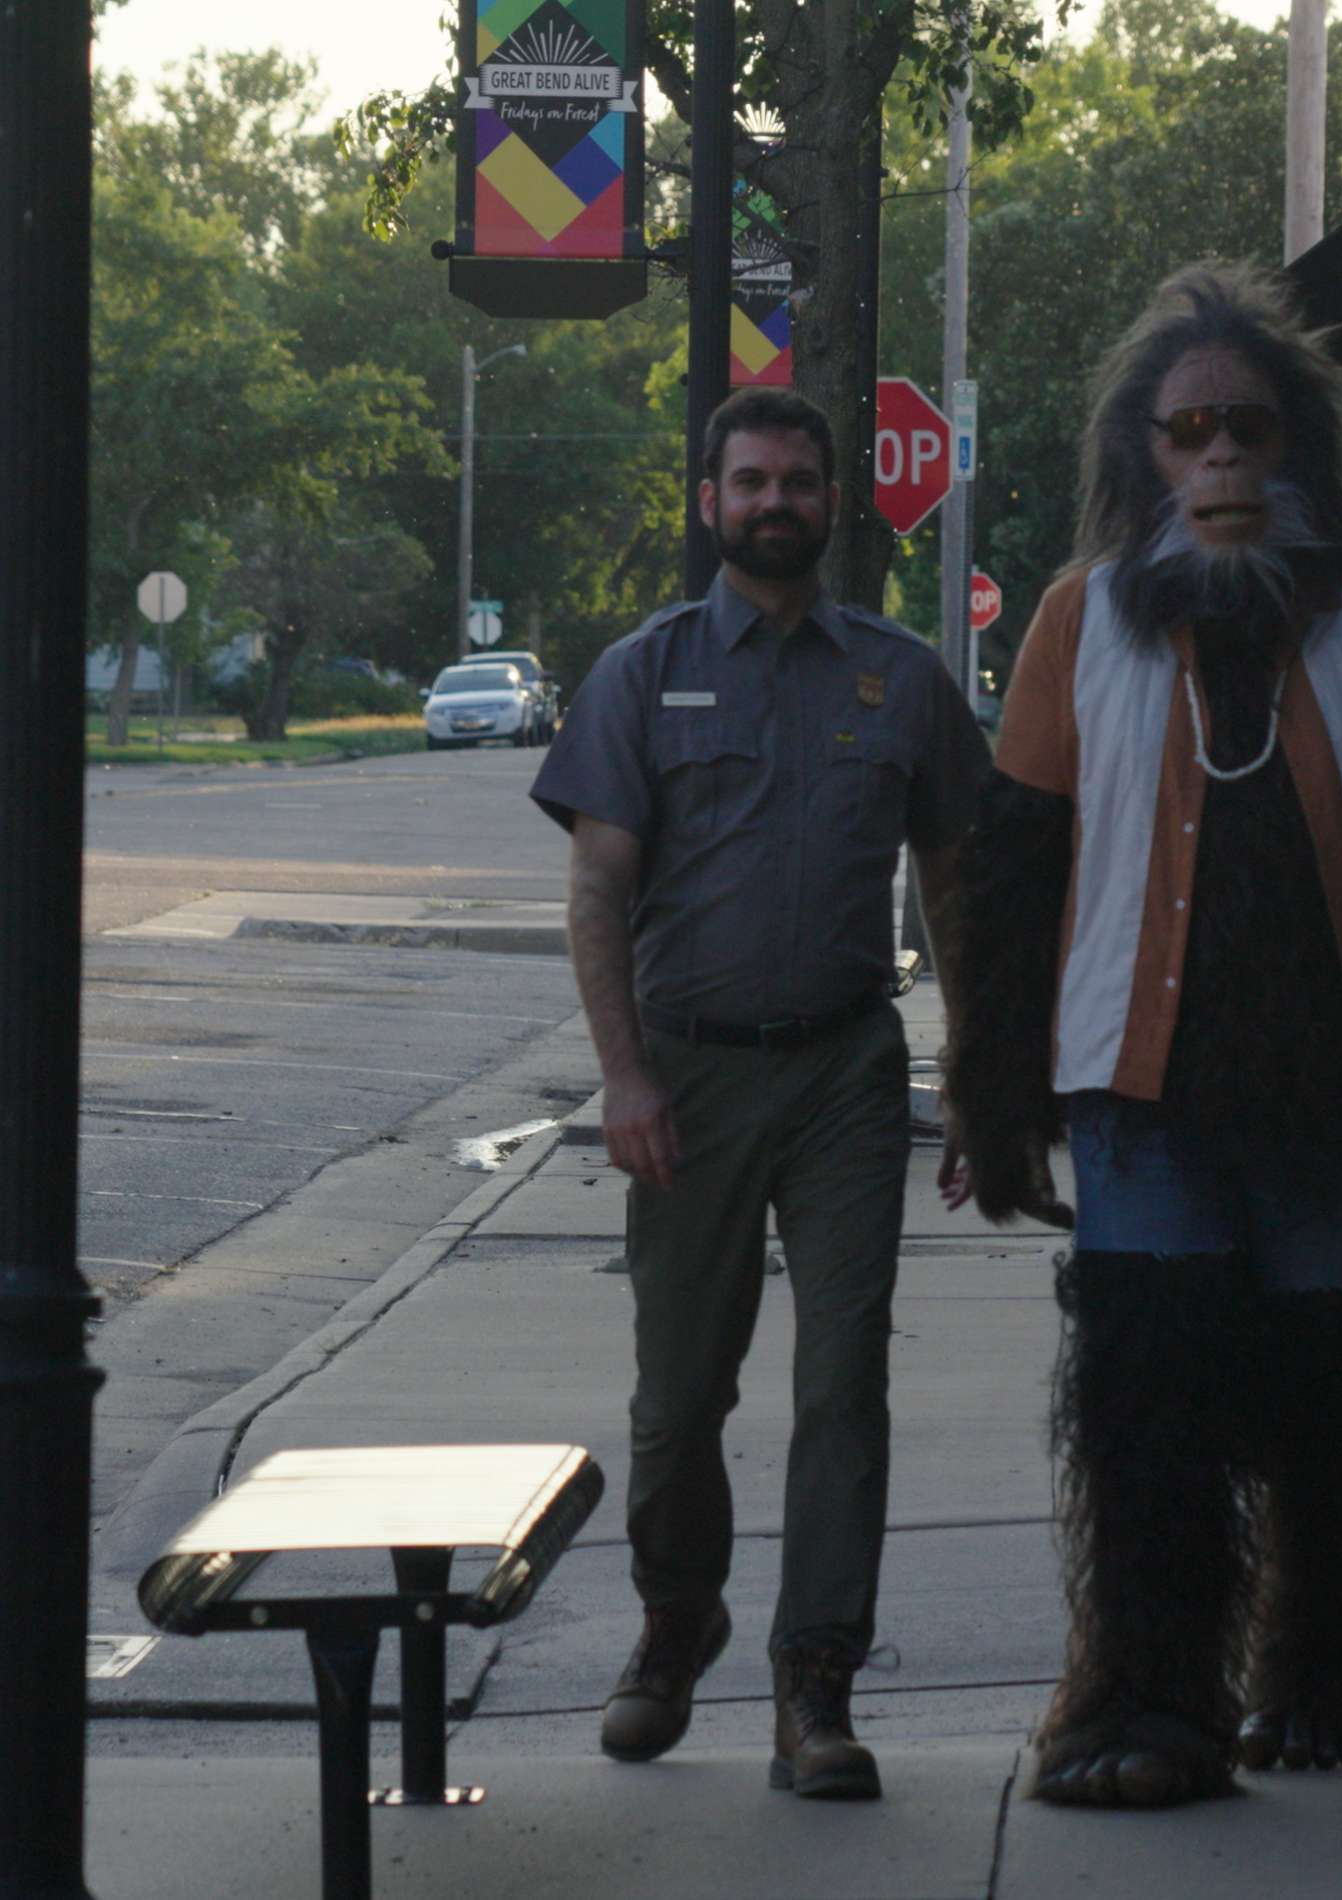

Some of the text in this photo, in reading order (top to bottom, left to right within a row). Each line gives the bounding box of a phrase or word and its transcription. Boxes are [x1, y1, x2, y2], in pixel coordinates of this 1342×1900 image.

[491, 71, 610, 91] GREAT BEND ALIVE
[500, 101, 600, 131] Fridays on Forest
[875, 429, 941, 486] OP
[971, 591, 998, 610] OP
